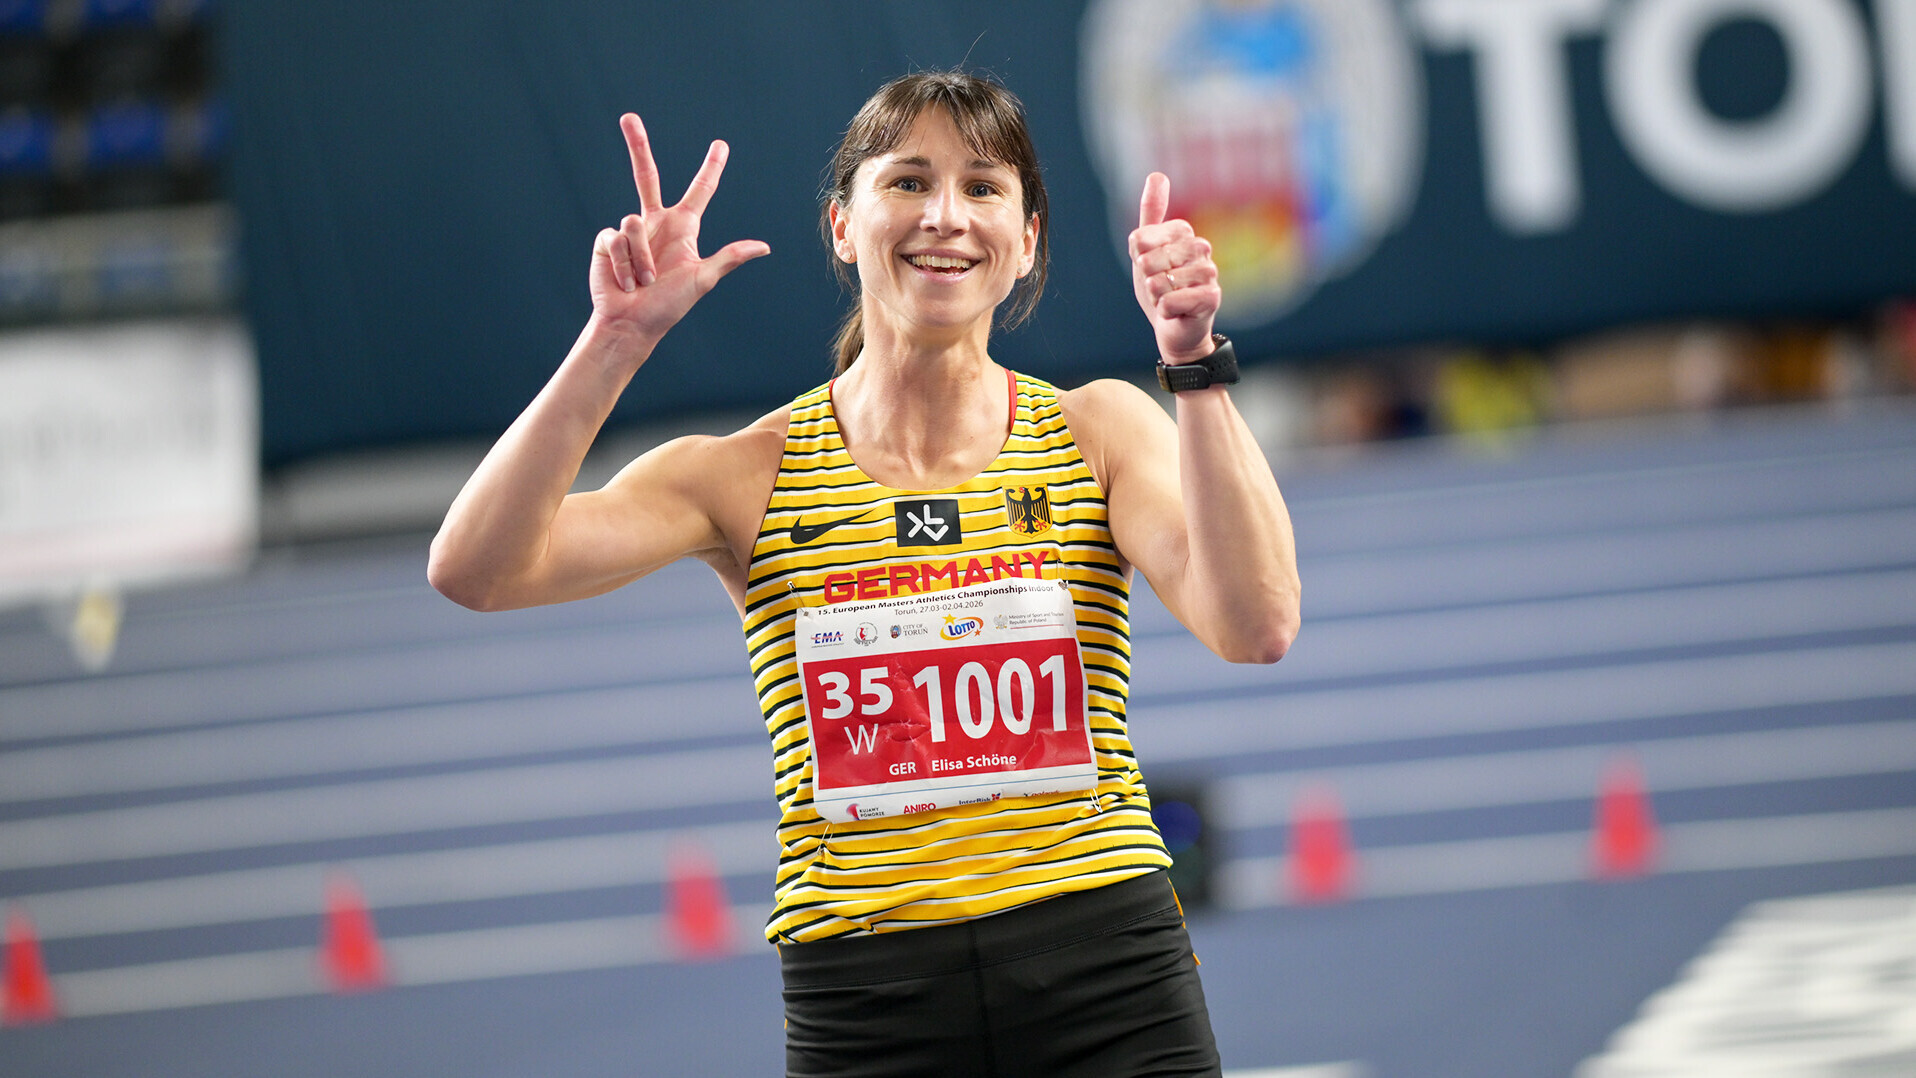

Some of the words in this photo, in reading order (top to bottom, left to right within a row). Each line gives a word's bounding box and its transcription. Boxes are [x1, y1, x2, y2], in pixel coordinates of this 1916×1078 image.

[1421, 0, 1916, 234] TO
[824, 551, 1050, 604] GERMANY
[833, 603, 876, 614] European
[878, 599, 914, 608] Masters
[915, 594, 956, 604] Athletics
[957, 585, 1028, 599] Championships
[1028, 585, 1054, 593] Indoor
[920, 600, 984, 613] 27.03-02.04.2026
[814, 631, 843, 644] EMA
[818, 666, 894, 720] 35
[912, 654, 1068, 743] 1001
[844, 723, 879, 755] W
[889, 762, 917, 776] GER
[931, 758, 964, 772] Elisa
[967, 753, 1017, 768] Schöne
[903, 802, 937, 814] ANIRO
[959, 797, 991, 805] InterRisk
